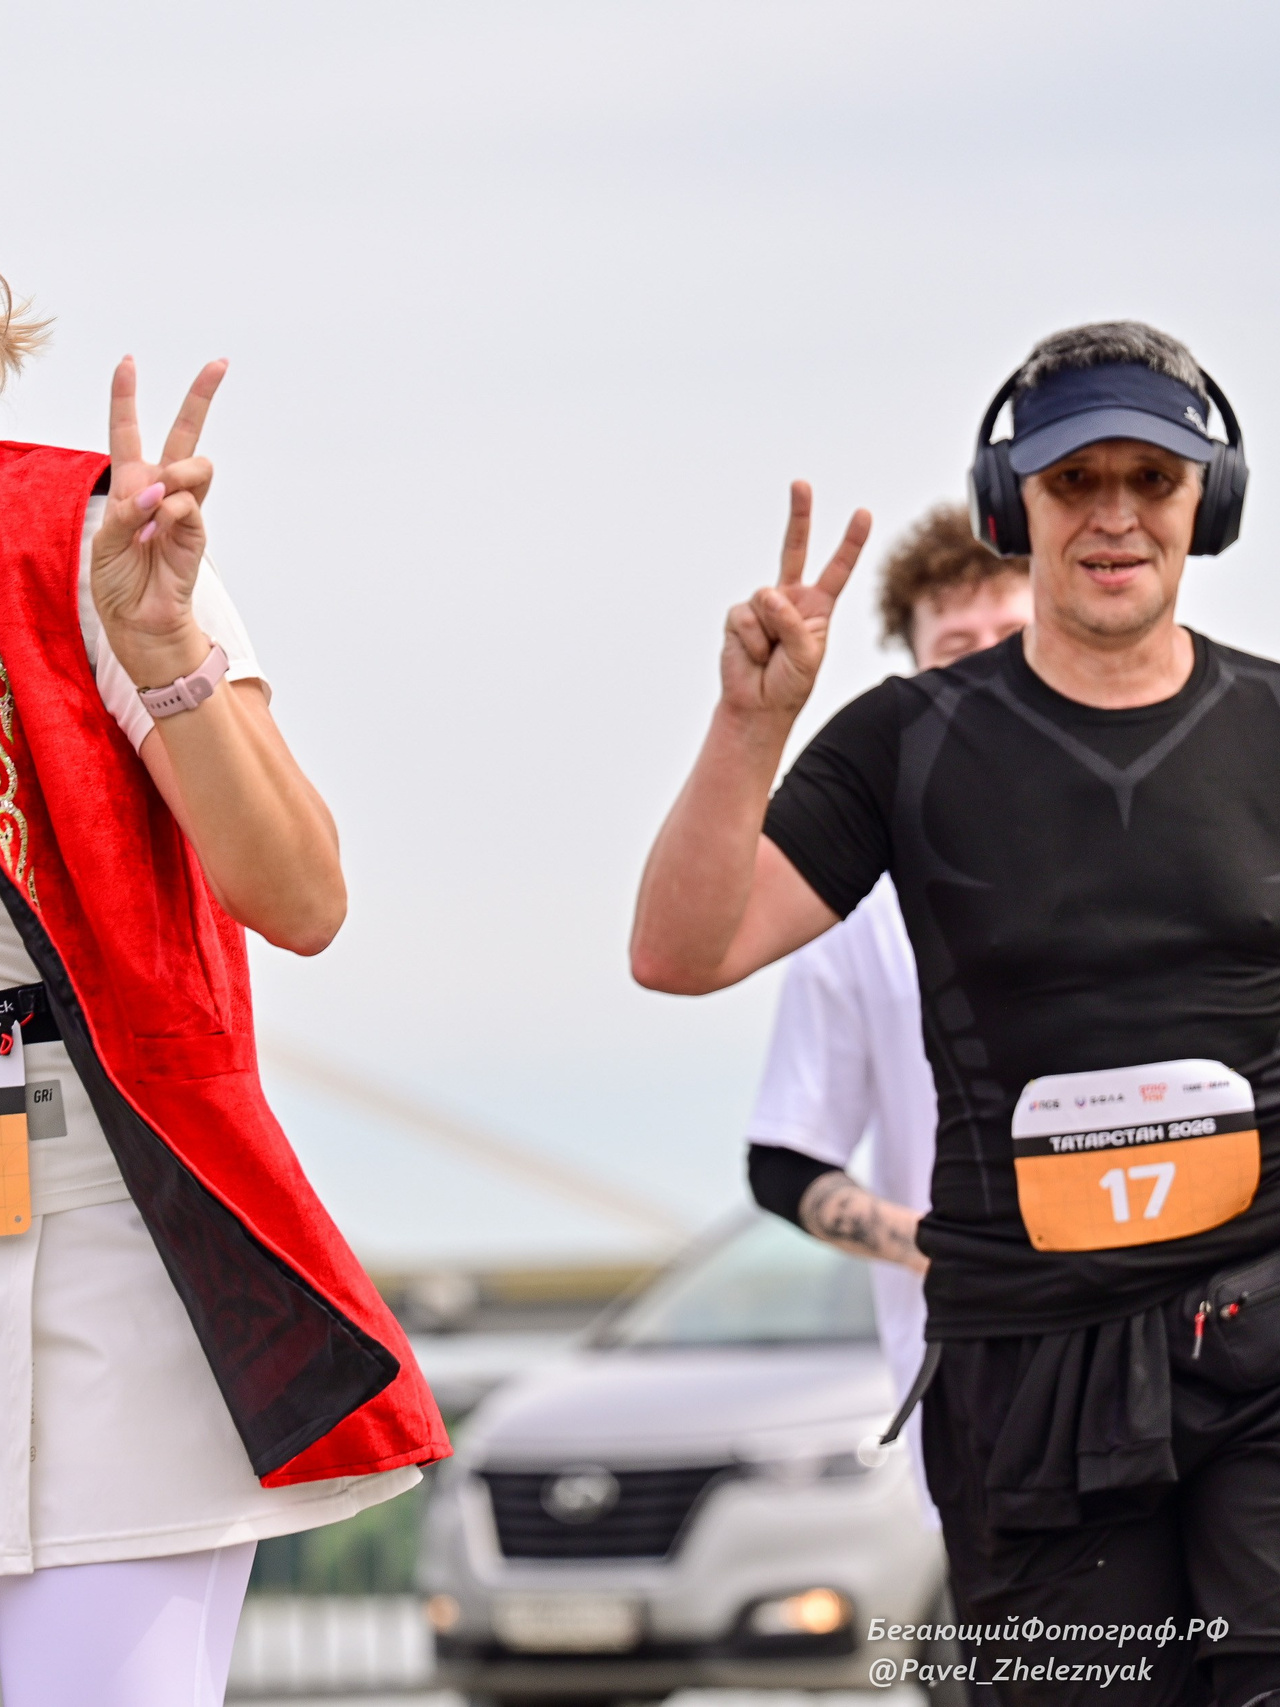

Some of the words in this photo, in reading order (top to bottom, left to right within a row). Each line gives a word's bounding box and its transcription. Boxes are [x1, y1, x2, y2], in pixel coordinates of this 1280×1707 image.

[33, 1088, 53, 1104] GRi
[1050, 1125, 1164, 1152] ТАТАРСТАН
[1168, 1118, 1216, 1139] 2026
[1099, 1162, 1176, 1223] 17
